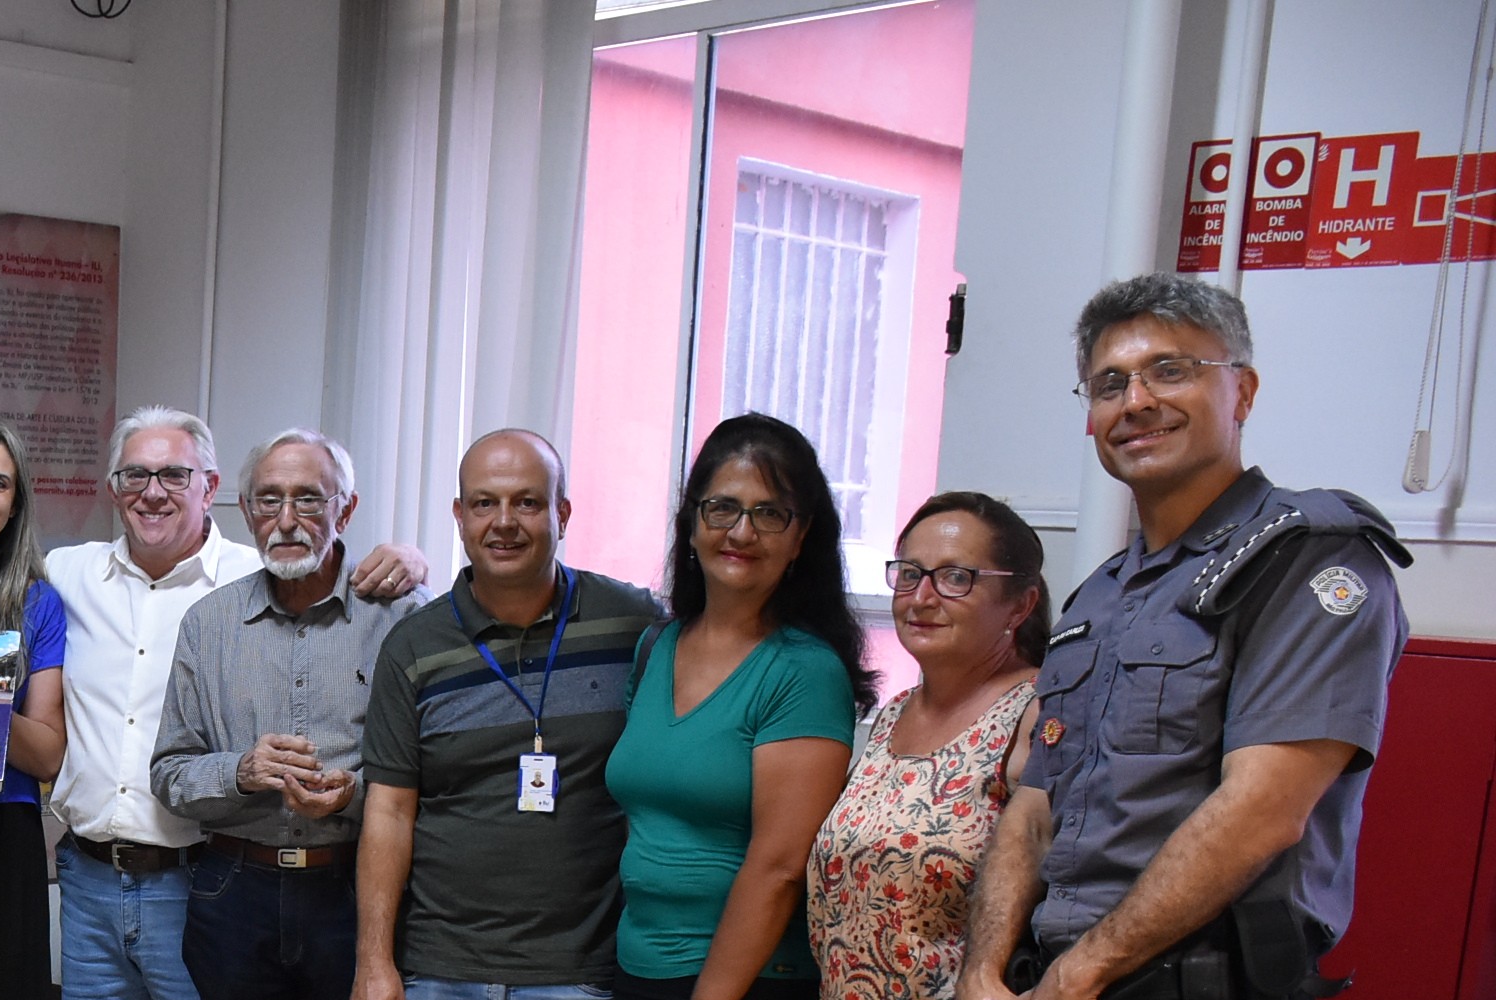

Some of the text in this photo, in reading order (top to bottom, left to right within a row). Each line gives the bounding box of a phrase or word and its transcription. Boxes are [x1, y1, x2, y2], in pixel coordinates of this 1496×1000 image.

[1333, 144, 1395, 209] H
[1189, 203, 1226, 216] ALAR
[1255, 198, 1303, 212] BOMBA
[1205, 219, 1221, 230] DE
[1269, 215, 1285, 227] DE
[1318, 216, 1395, 235] HIDRANTE
[1184, 233, 1224, 246] INCÊND
[1246, 226, 1304, 244] INCÊNDIO
[6, 252, 52, 267] Legislativo
[1, 264, 46, 280] Resolução
[60, 270, 103, 284] 236/2013
